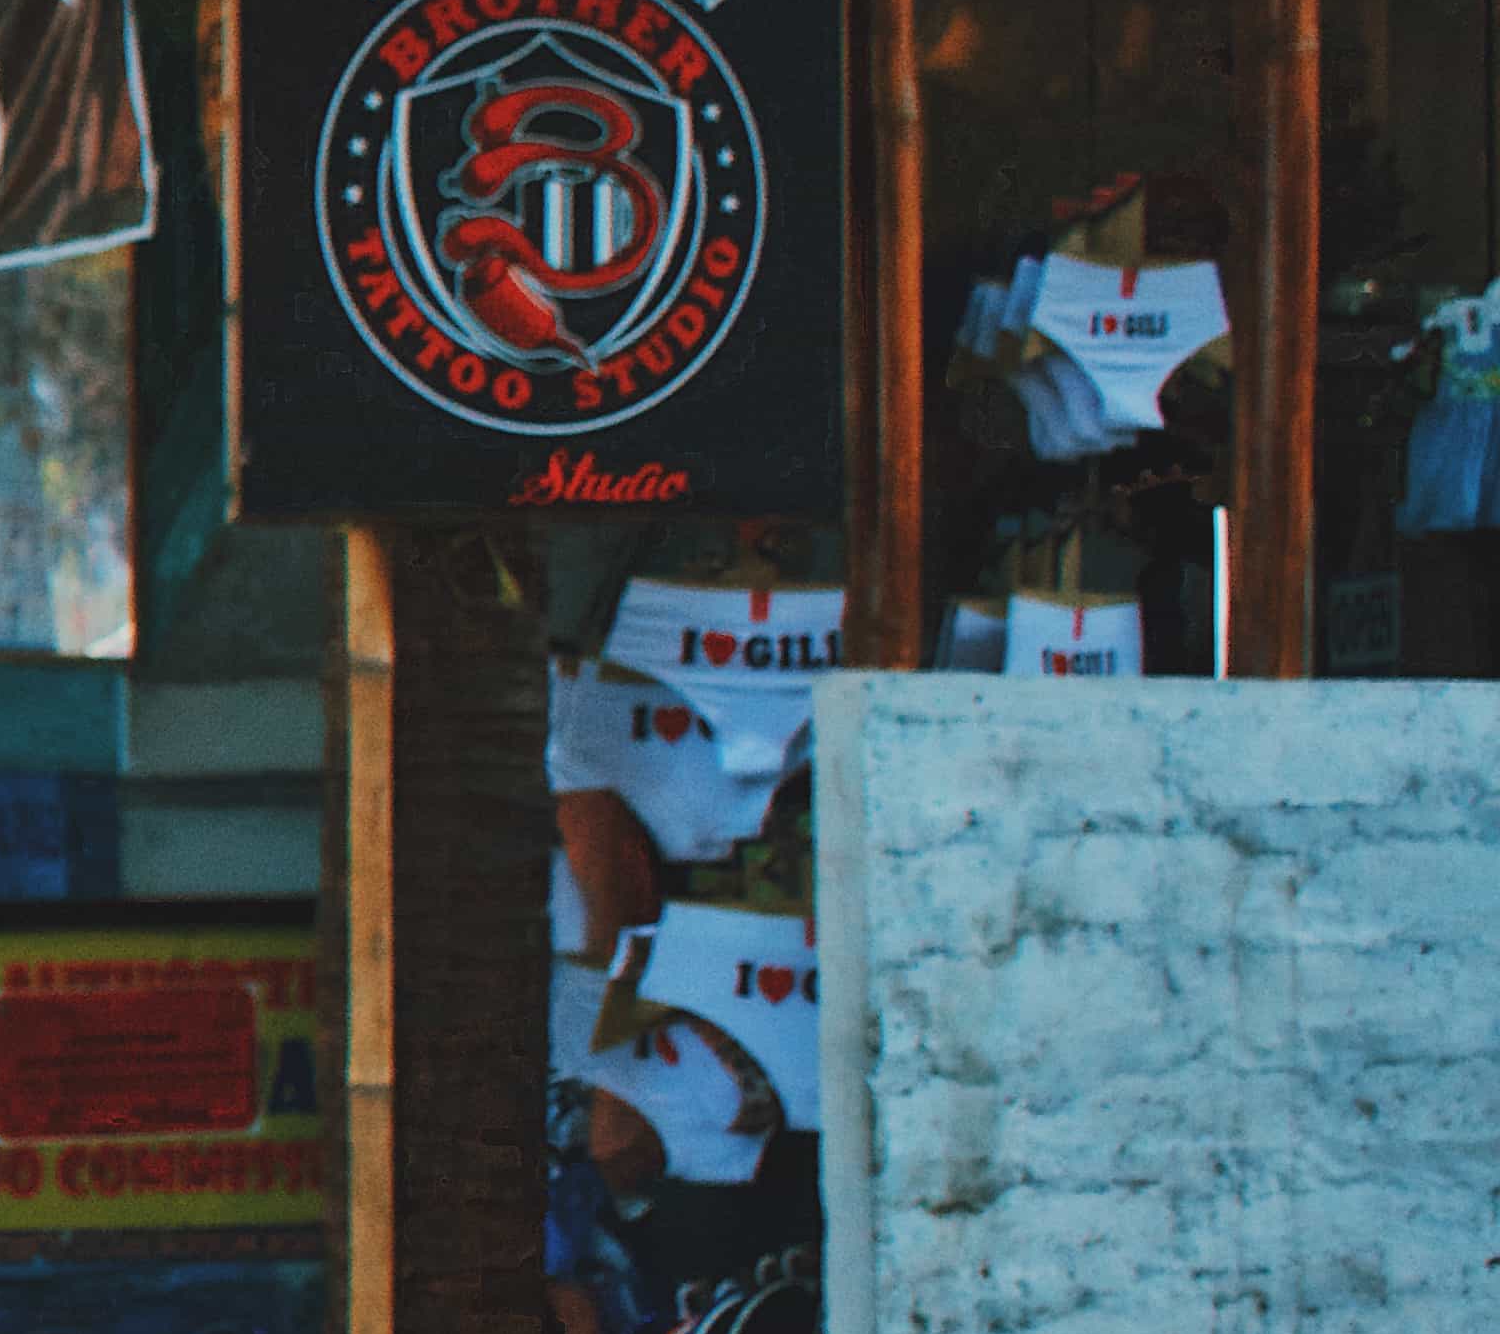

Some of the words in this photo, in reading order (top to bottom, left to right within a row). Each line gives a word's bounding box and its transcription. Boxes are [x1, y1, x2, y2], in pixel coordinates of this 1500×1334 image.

[347, 227, 533, 410] TATTOO
[572, 236, 740, 409] STUDIO
[508, 449, 690, 506] Studio
